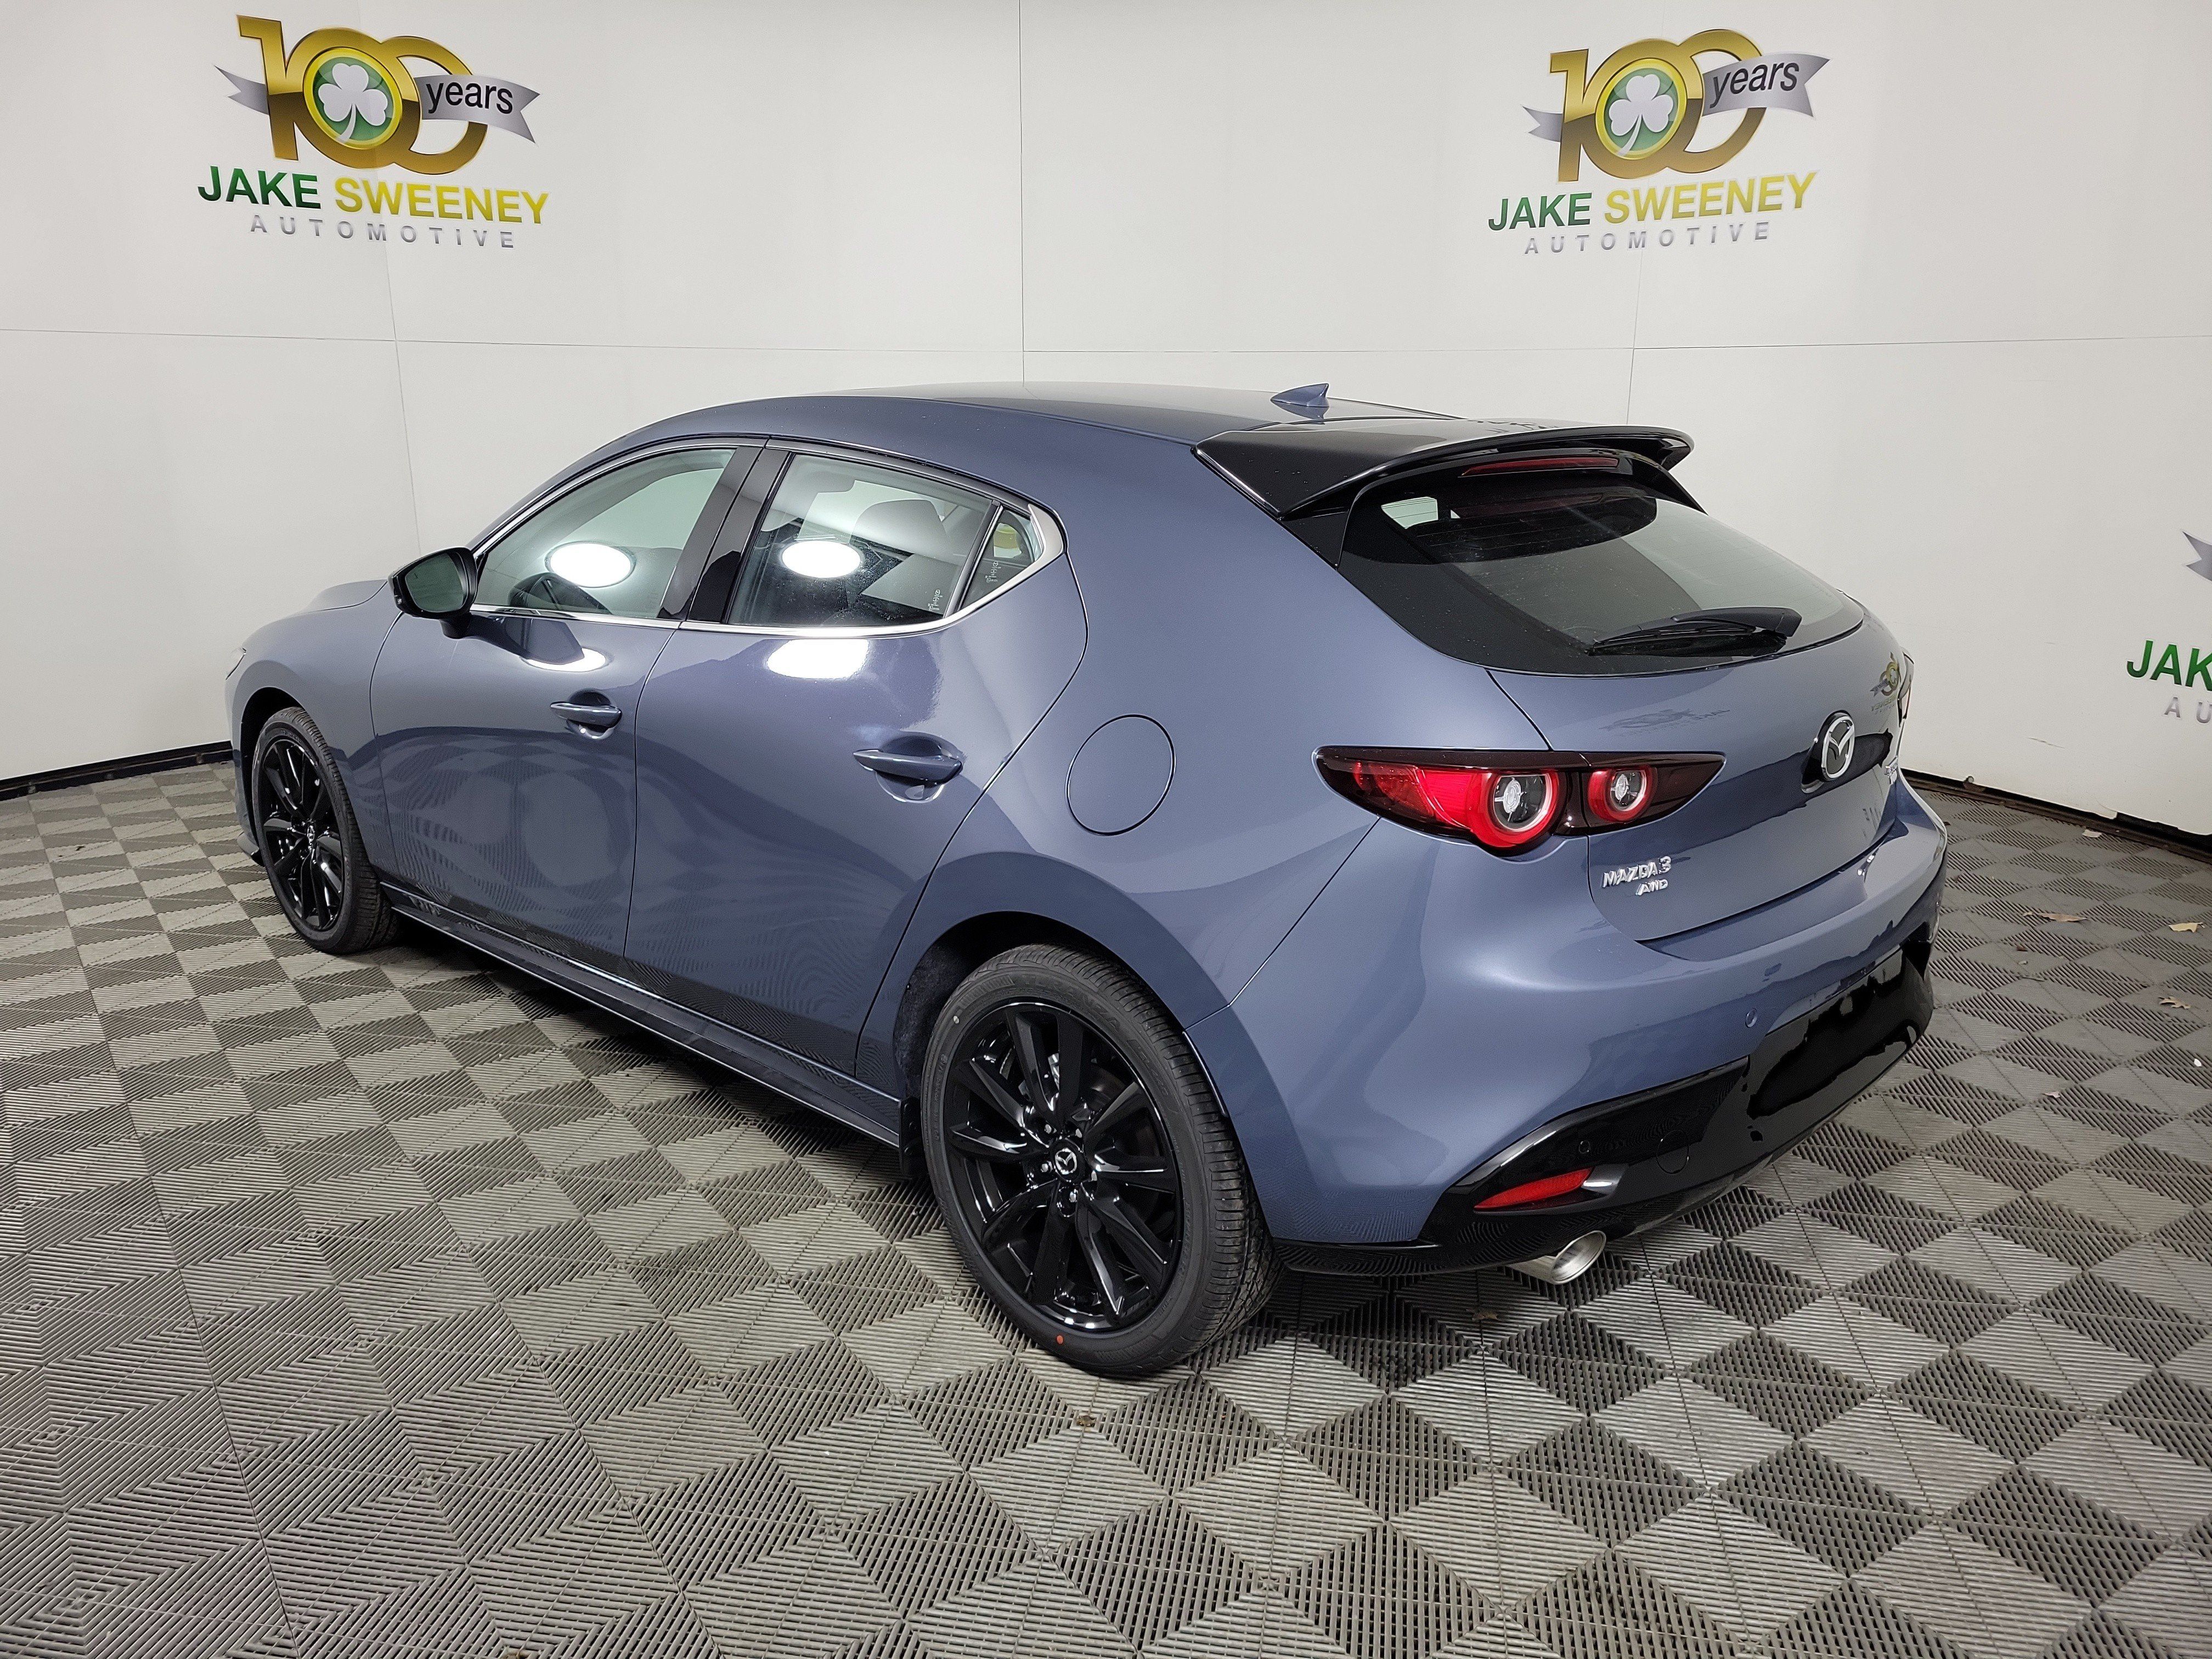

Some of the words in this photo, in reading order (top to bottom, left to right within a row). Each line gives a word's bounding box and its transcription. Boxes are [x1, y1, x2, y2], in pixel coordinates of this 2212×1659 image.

[426, 81, 514, 114] years
[1710, 62, 1799, 108] years
[198, 166, 321, 209] JAKE
[335, 178, 549, 224] SWEENEY
[1488, 192, 1592, 230] JAKE
[1604, 172, 1818, 224] SWEENEY
[250, 215, 514, 249] AUTOMOTIVE
[1524, 222, 1769, 255] AUTOMOTIVE
[1635, 879, 1668, 896] AWD
